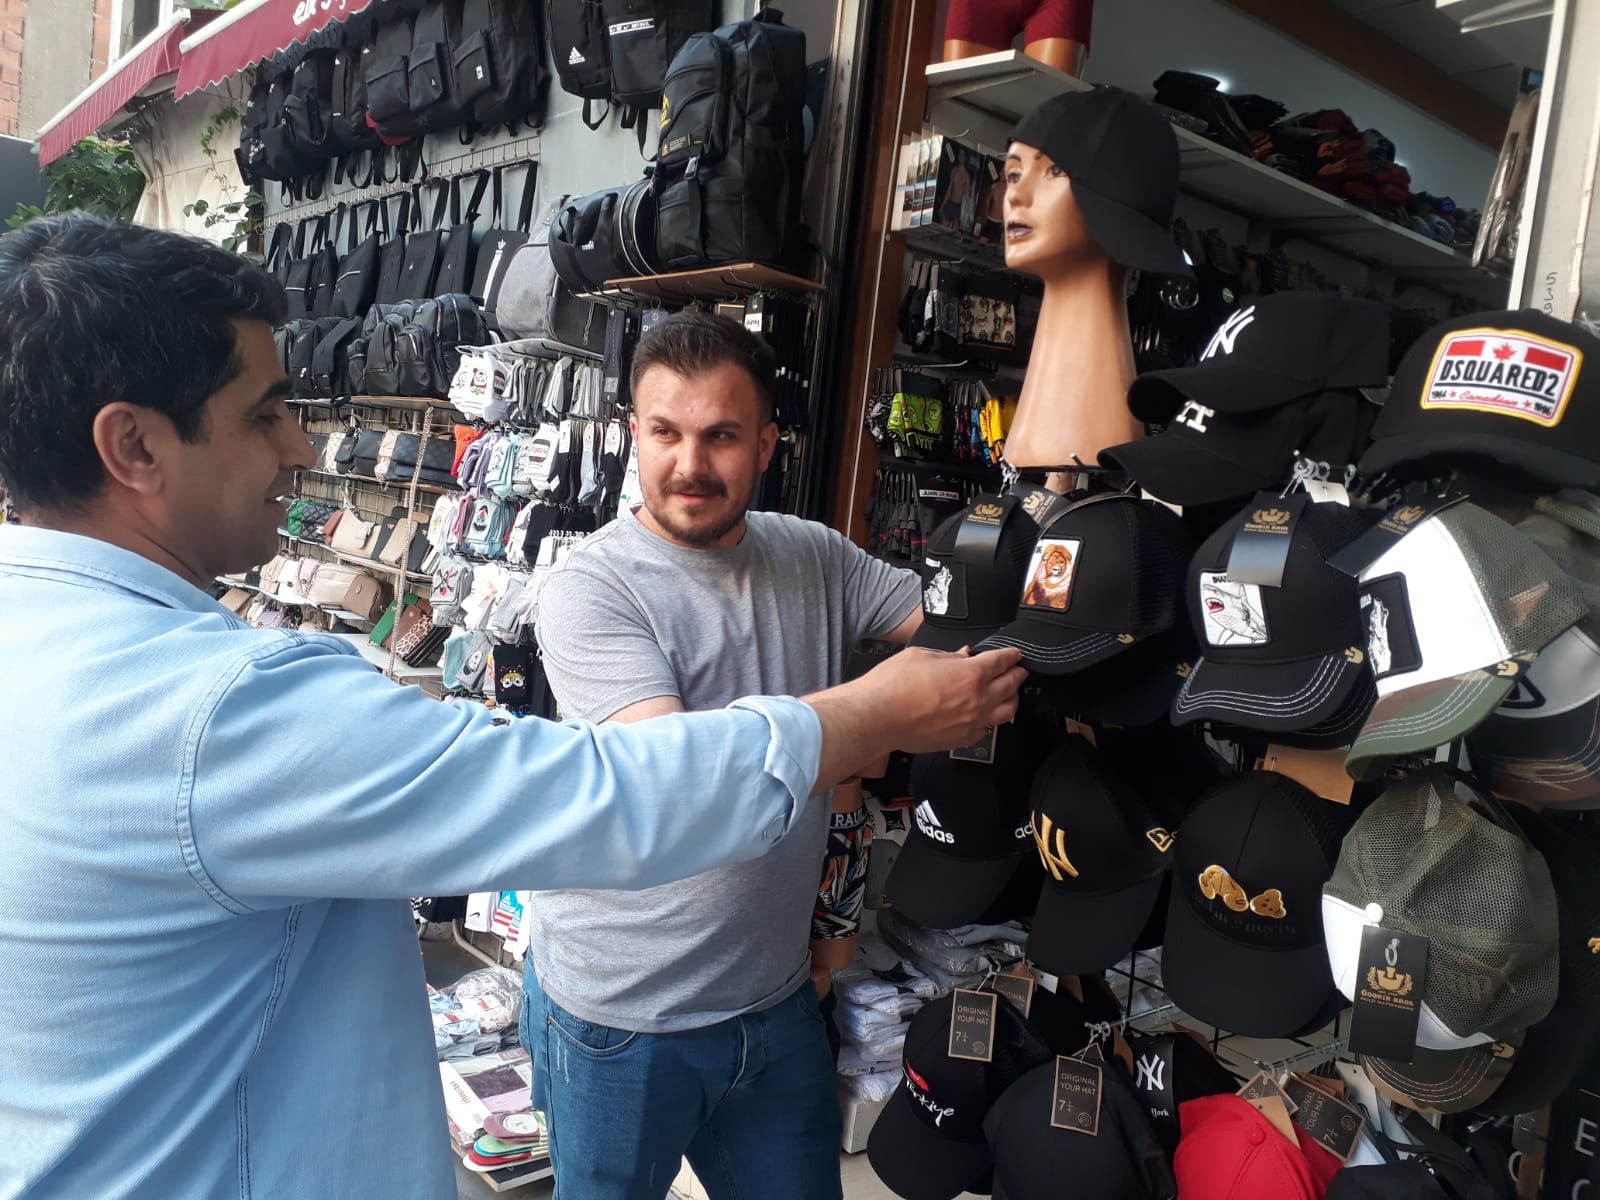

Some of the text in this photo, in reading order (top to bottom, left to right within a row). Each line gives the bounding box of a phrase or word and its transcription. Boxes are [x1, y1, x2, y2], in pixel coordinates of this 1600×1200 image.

[1438, 359, 1560, 397] DSQUARED2
[957, 1004, 990, 1016] ORIGINAL
[957, 1014, 990, 1025] YOUR HAT
[1061, 1072, 1097, 1086] ORIGINAL
[1060, 1082, 1096, 1096] YOUR HAT
